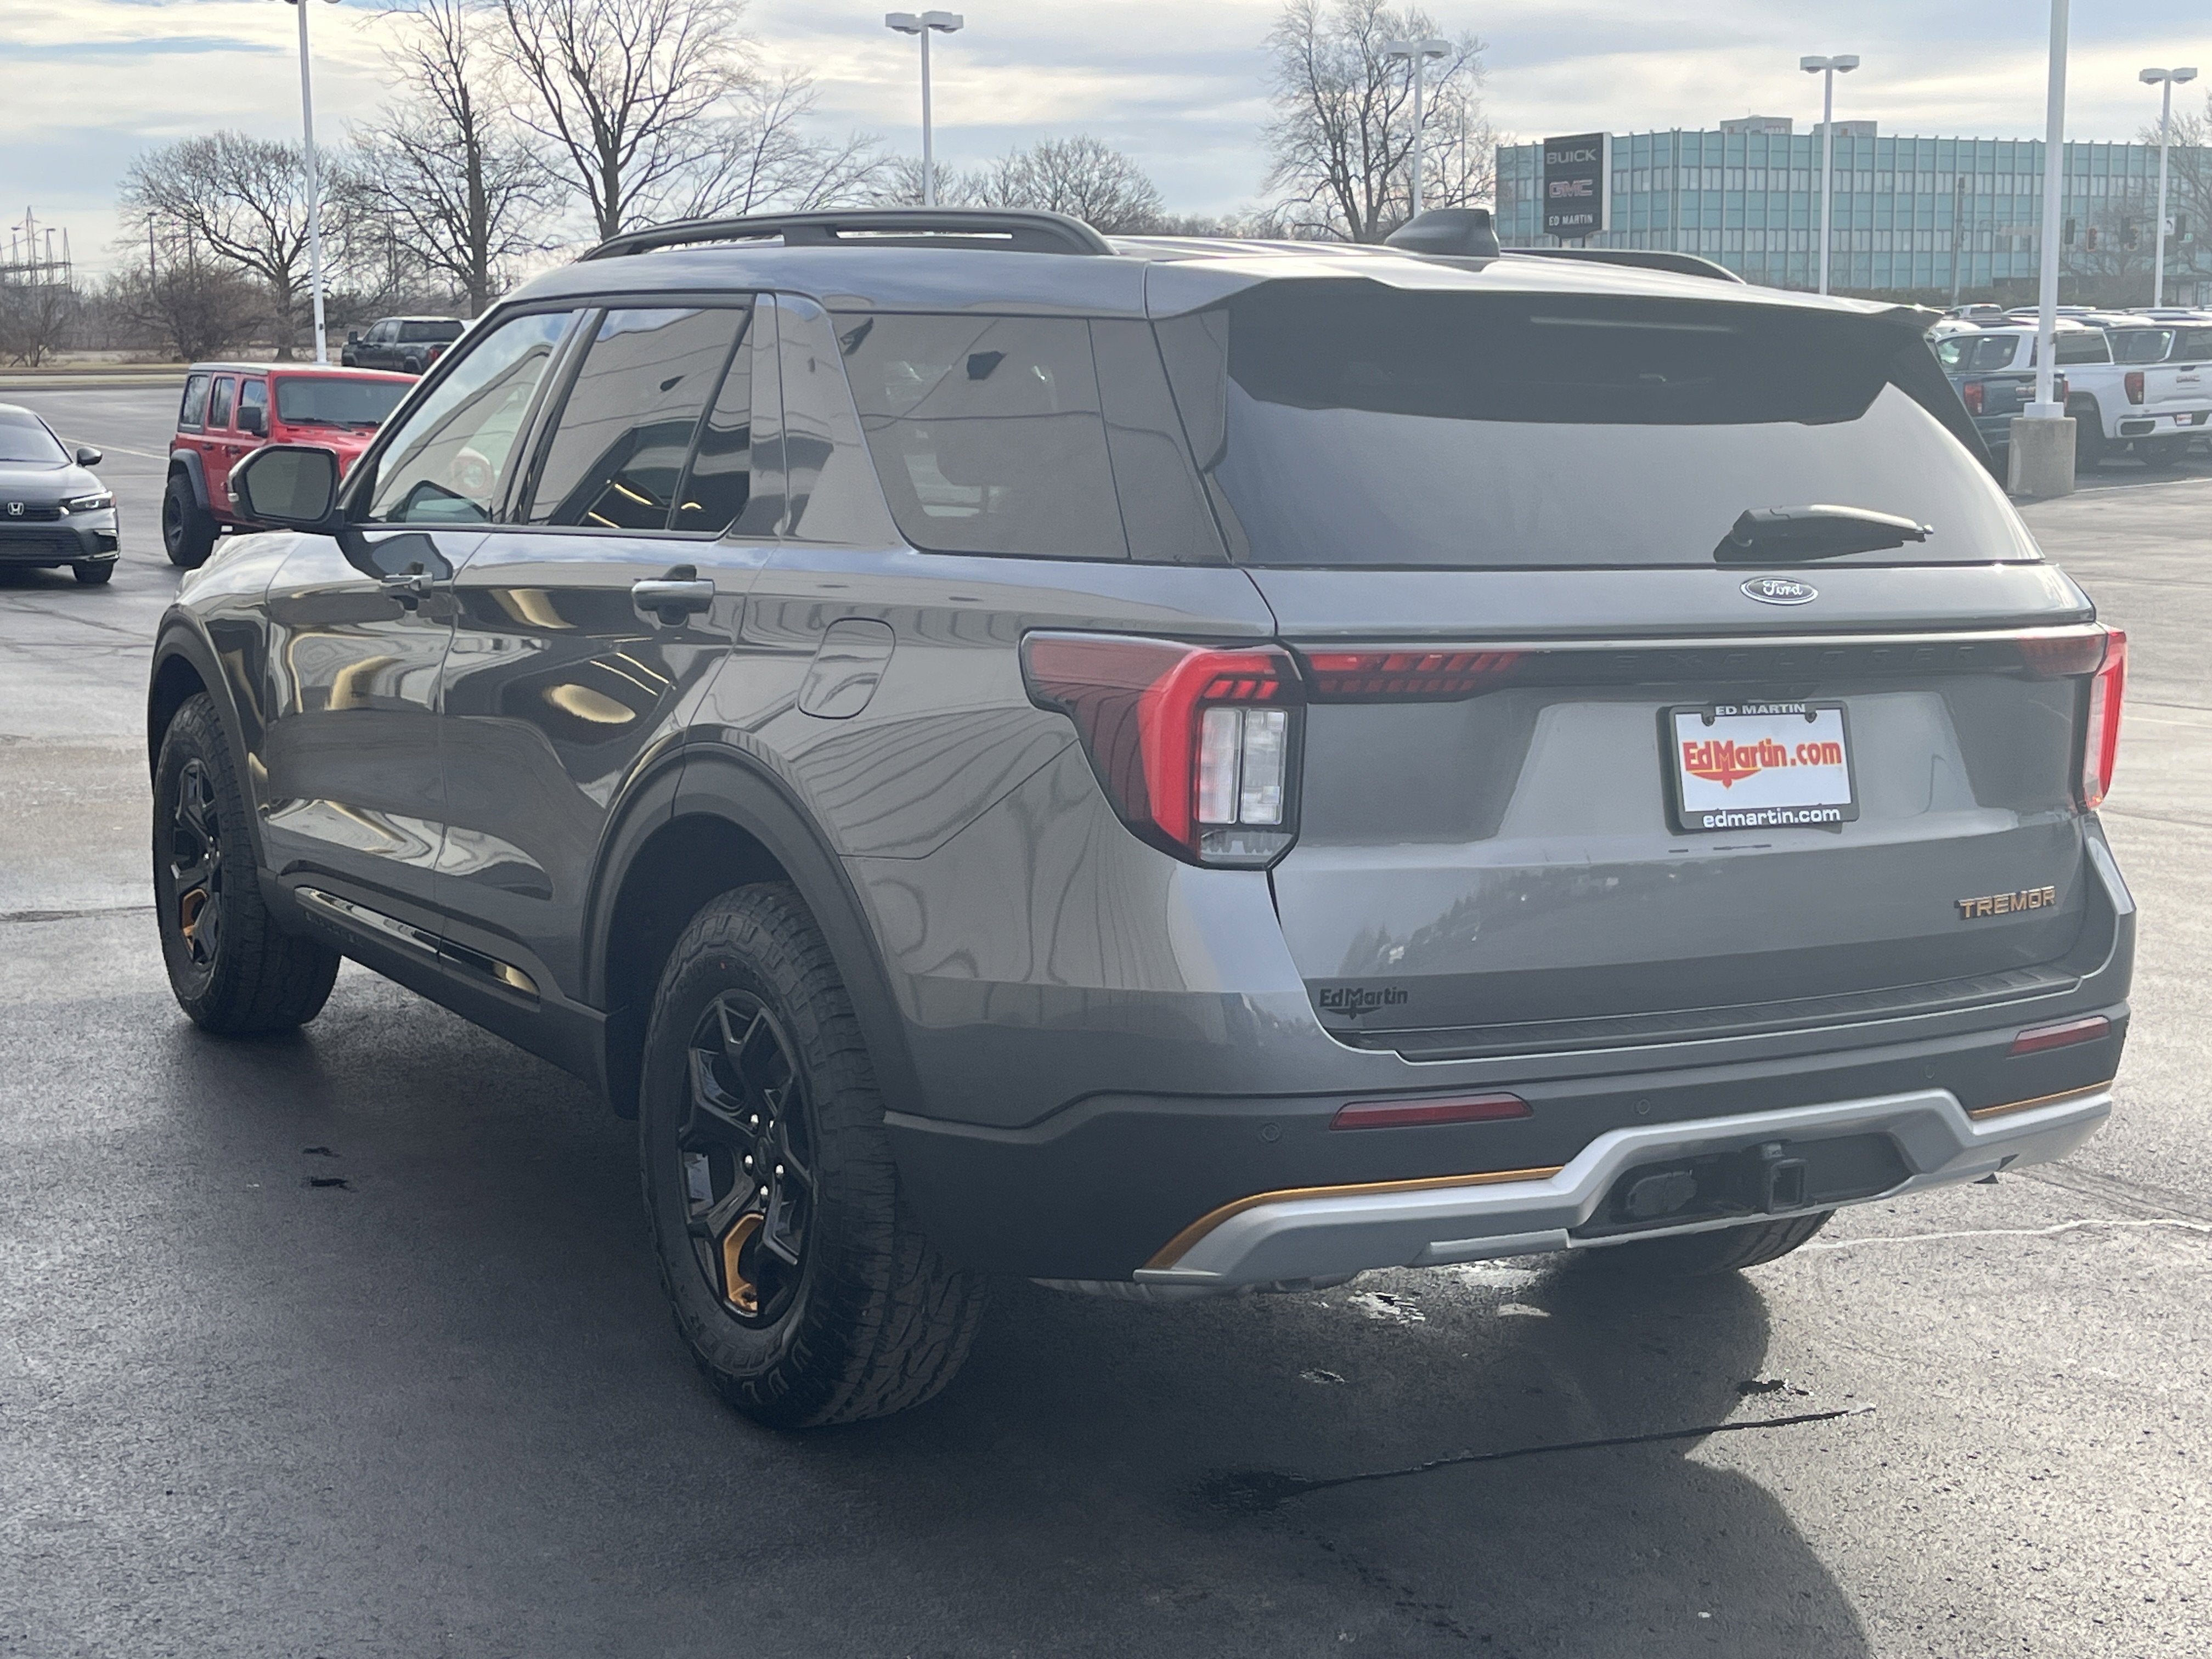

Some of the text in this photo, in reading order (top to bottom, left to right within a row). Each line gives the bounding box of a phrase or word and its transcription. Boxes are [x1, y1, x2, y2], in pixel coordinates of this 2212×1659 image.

[1545, 148, 1597, 165] BUICK
[1548, 179, 1594, 199] GMC
[1548, 214, 1593, 226] ED MARTIN
[1762, 580, 1803, 596] Ford
[1715, 704, 1805, 715] ED MARTIN
[1682, 738, 1842, 771] EdMartin.com
[1702, 808, 1841, 829] edmartin.com
[1957, 885, 2056, 918] TREMOR
[1319, 986, 1408, 1007] EdMartin
